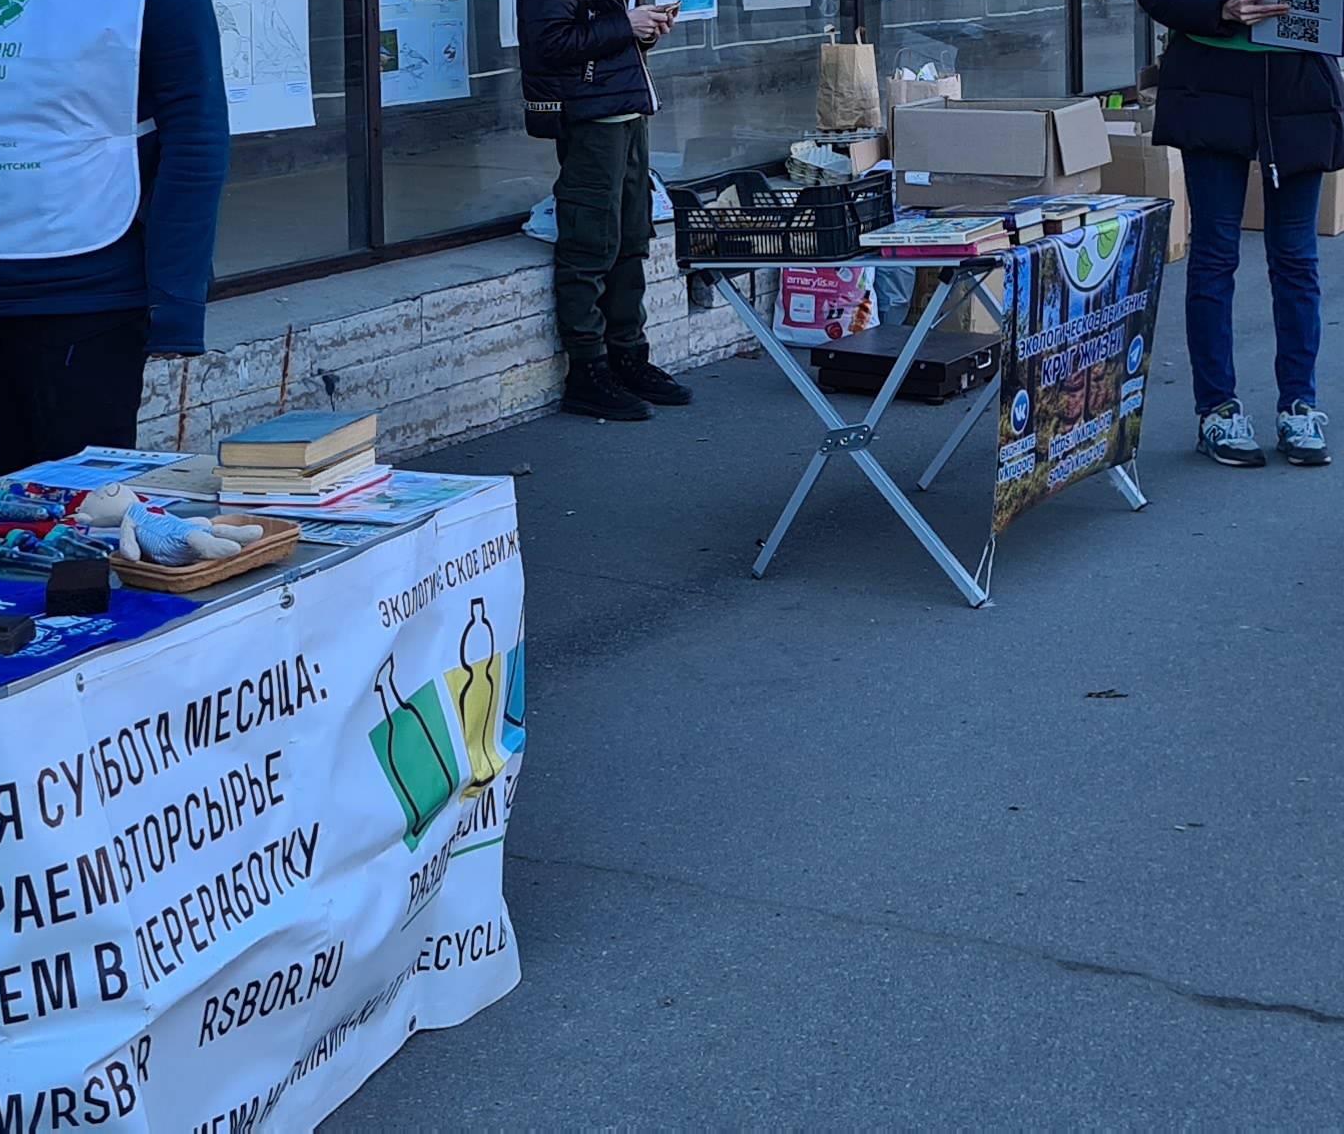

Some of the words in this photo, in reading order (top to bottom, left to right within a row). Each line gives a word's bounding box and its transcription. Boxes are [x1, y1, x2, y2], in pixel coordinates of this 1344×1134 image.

[1017, 309, 1102, 360] ЭКОЛОГИЧЕСКОЕ
[1041, 346, 1078, 387] КРУГ
[378, 549, 480, 628] ЭКОЛОГИСКОЕ
[184, 653, 329, 756] МЕСЯЦА:
[112, 749, 285, 896] ВТОРСЫРЬЕ
[94, 941, 129, 1003] В
[198, 940, 345, 1048] RSBOR.RU
